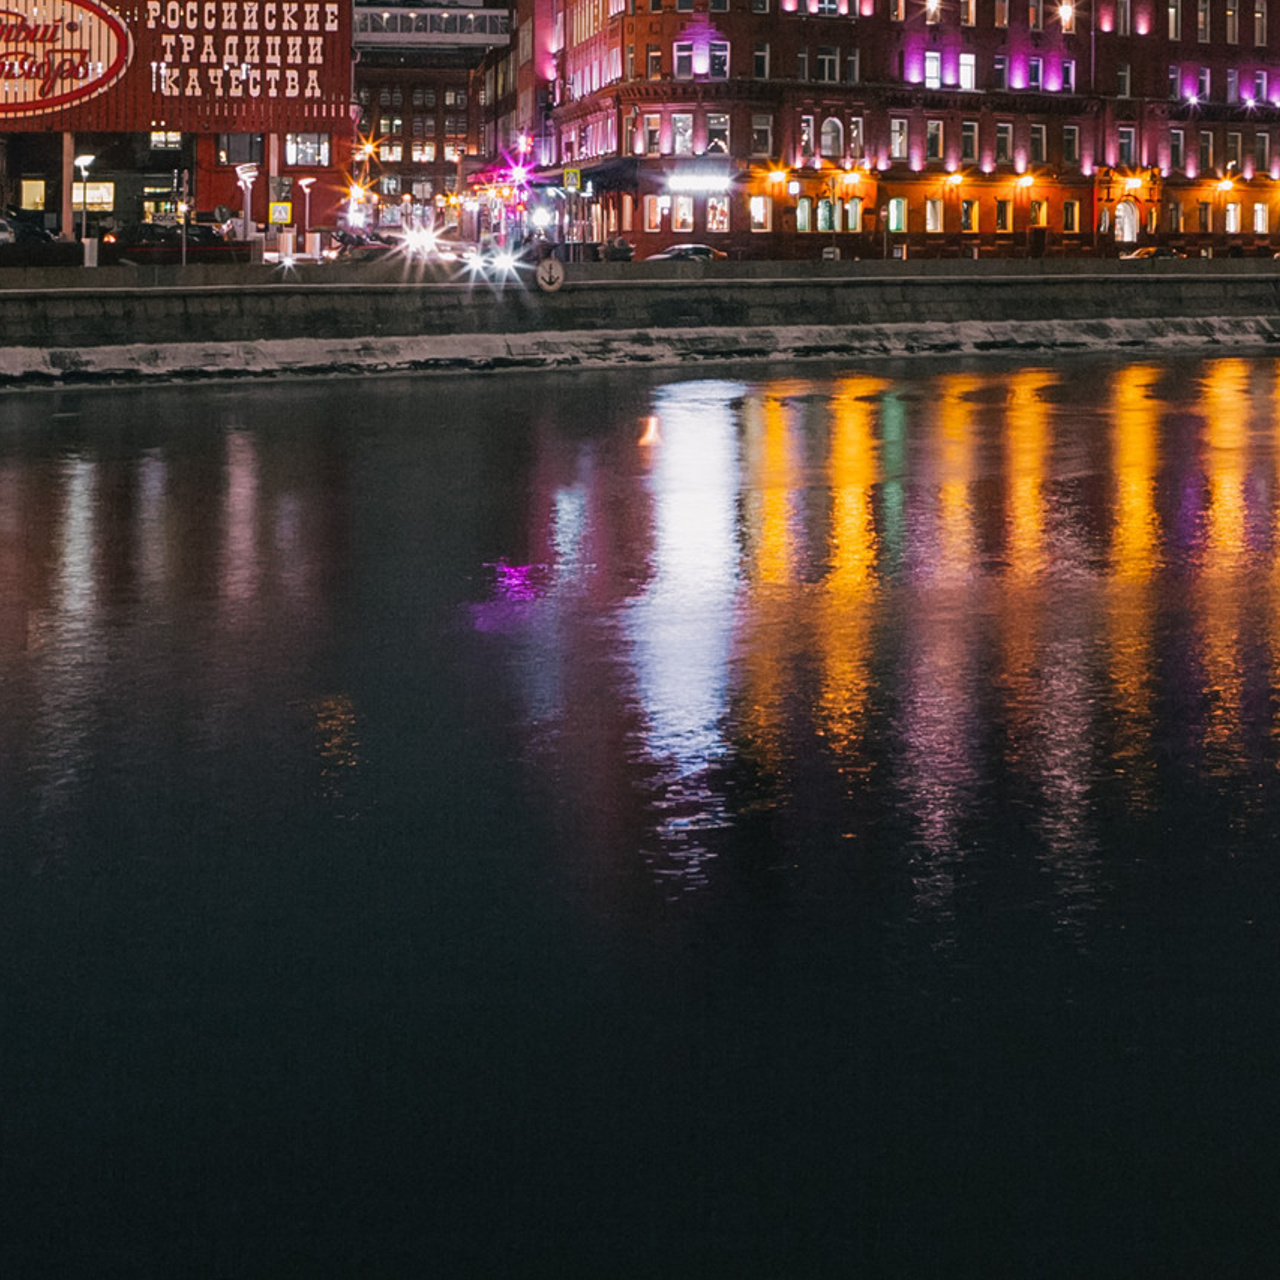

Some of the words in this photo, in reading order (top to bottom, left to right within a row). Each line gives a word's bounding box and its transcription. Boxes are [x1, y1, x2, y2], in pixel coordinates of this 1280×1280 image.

[147, 0, 339, 32] РОССИЙСКИЕ
[161, 34, 324, 67] ТРАДИЦИИ
[163, 68, 322, 98] КАЧЕСТВА
